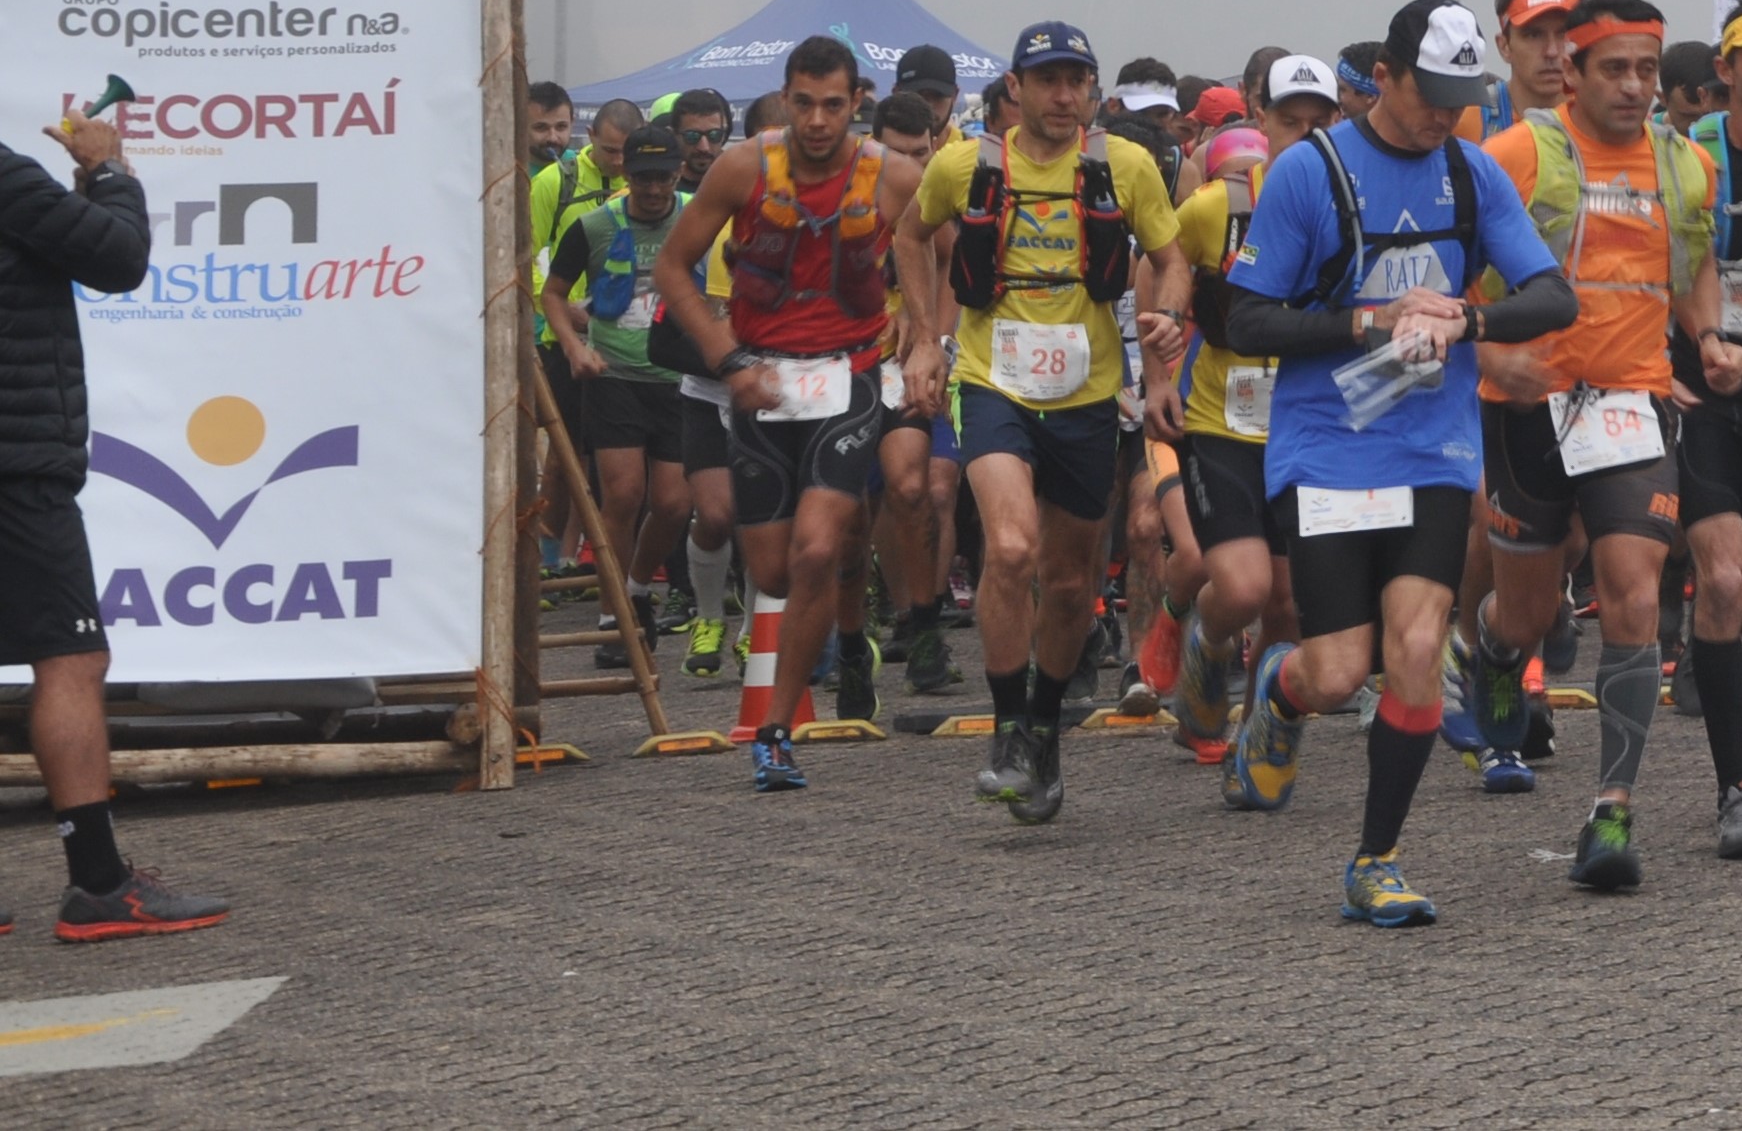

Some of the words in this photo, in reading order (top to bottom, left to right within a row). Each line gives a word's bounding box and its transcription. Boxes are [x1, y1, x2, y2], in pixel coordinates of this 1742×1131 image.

[57, 0, 337, 47] copicenter
[138, 46, 206, 59] produtos
[209, 48, 219, 57] e
[222, 44, 283, 58] serviços
[287, 42, 397, 57] personalizados
[952, 53, 995, 70] stor
[62, 77, 402, 140] ECORTAÍ
[180, 144, 223, 156] ideias
[1008, 236, 1077, 251] FACCAT
[74, 244, 425, 304] nstruarte
[1385, 255, 1432, 293] RATZ
[89, 306, 184, 324] engenharia
[190, 306, 208, 320] &
[213, 304, 302, 322] construção
[1030, 348, 1067, 375] 28
[797, 373, 828, 400] 12
[1602, 406, 1643, 438] 84
[98, 559, 392, 627] ACCAT
